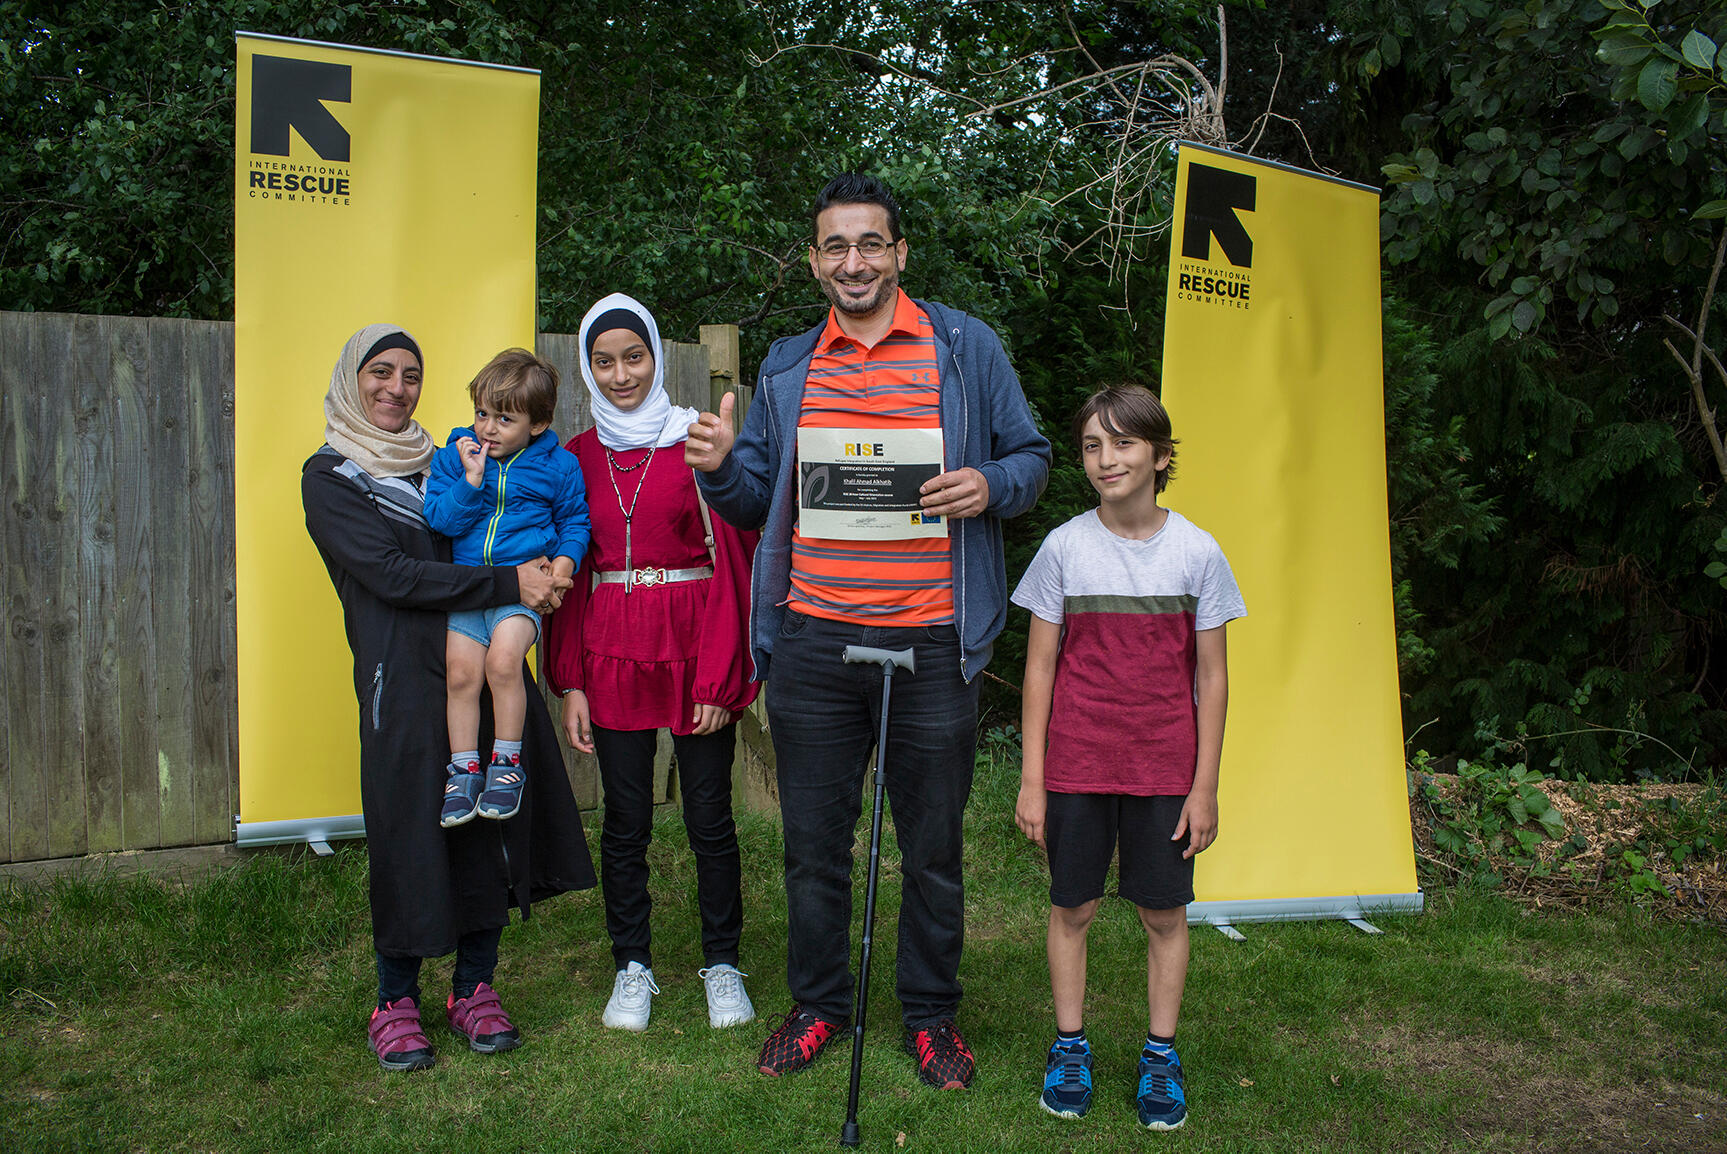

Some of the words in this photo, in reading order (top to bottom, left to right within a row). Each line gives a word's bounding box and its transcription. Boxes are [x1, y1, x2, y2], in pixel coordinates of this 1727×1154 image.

[249, 161, 351, 177] INTERNATIONAL
[249, 170, 350, 196] RESCUE
[249, 190, 350, 206] COMMITTEE
[1180, 264, 1251, 282] INTERNATIONAL
[1179, 273, 1250, 300] RESCUE
[1178, 292, 1249, 310] COMMITTEE
[844, 443, 884, 457] RISE
